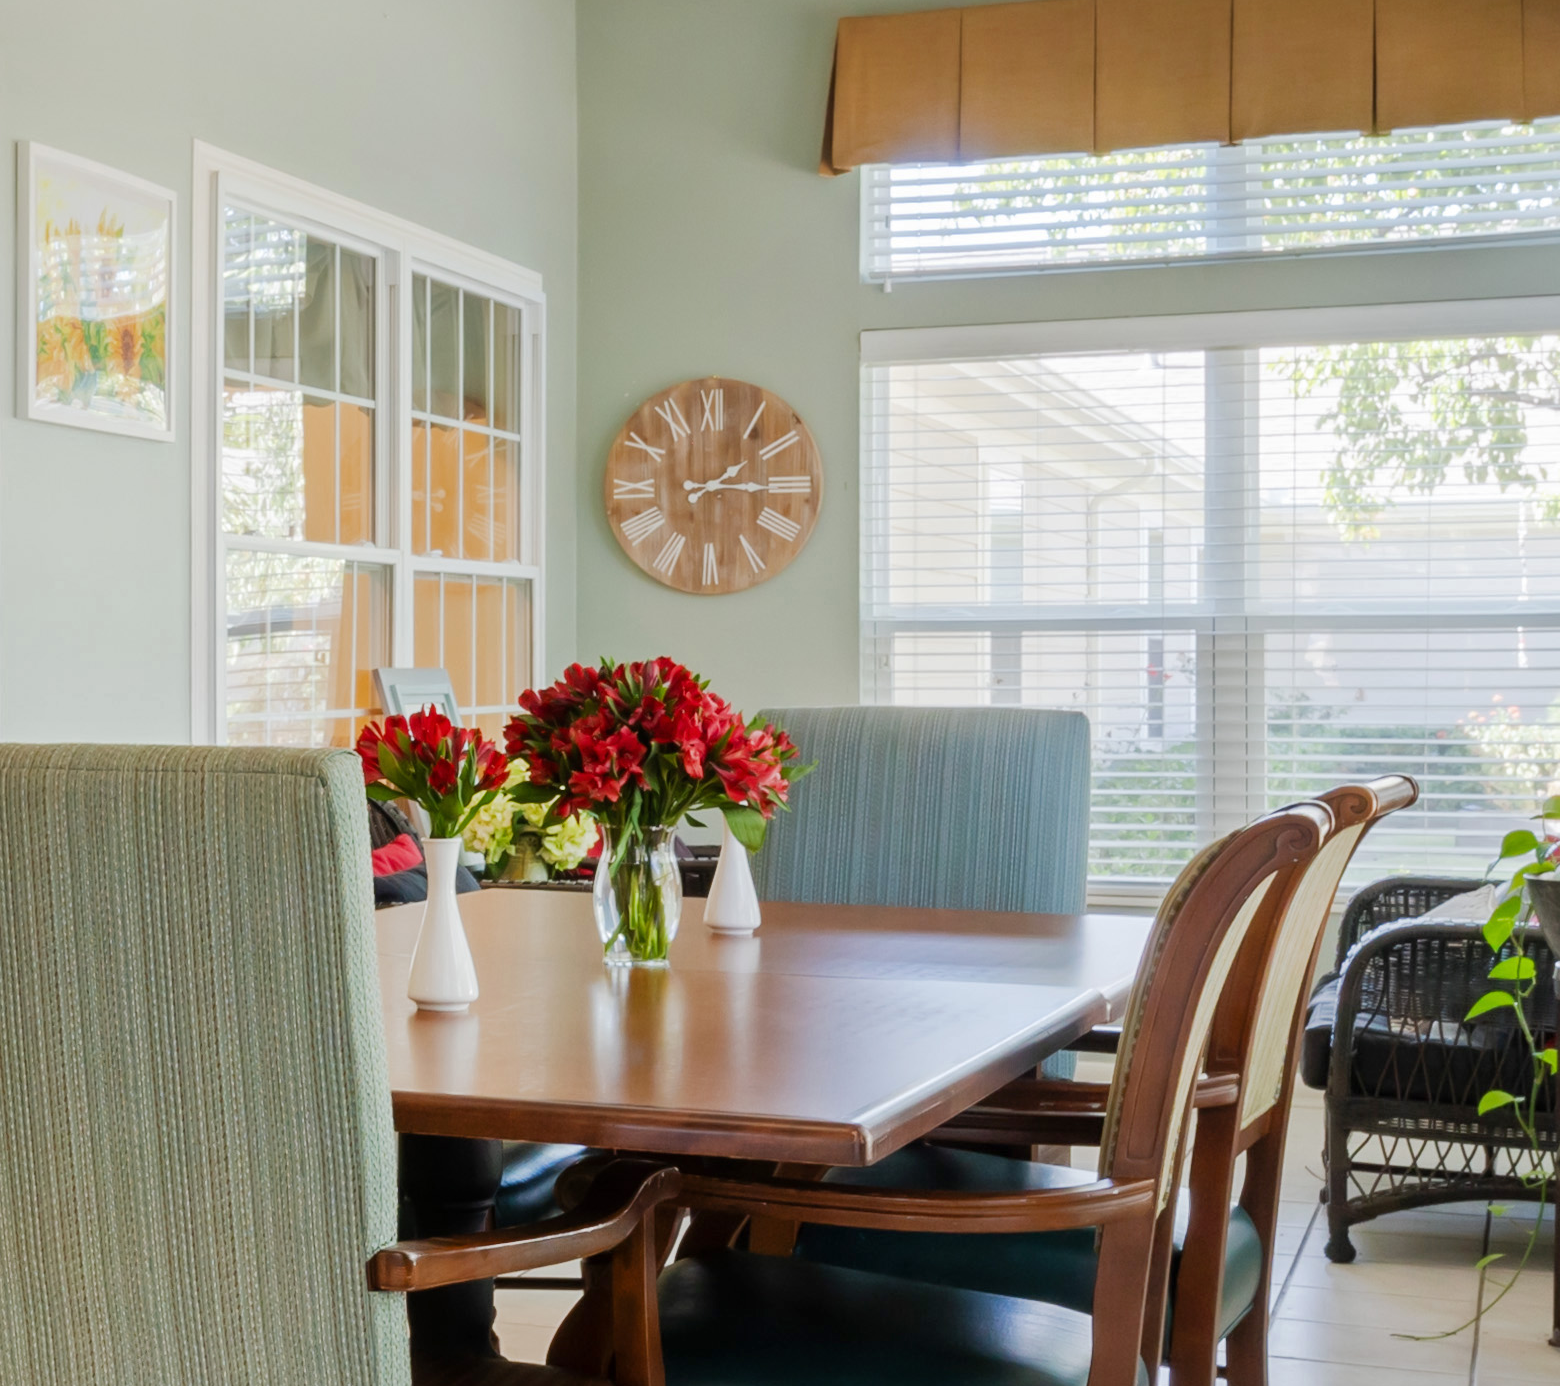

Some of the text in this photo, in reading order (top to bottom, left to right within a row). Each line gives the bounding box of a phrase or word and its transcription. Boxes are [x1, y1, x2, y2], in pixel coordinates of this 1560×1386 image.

[654, 398, 691, 441] XI
[701, 389, 723, 431] XII
[625, 432, 665, 462] X
[760, 431, 800, 460] II
[613, 479, 654, 499] IX
[768, 476, 811, 493] III
[621, 506, 665, 546] VIII
[653, 532, 686, 576] VII
[702, 543, 718, 585] VI
[739, 535, 765, 573] V
